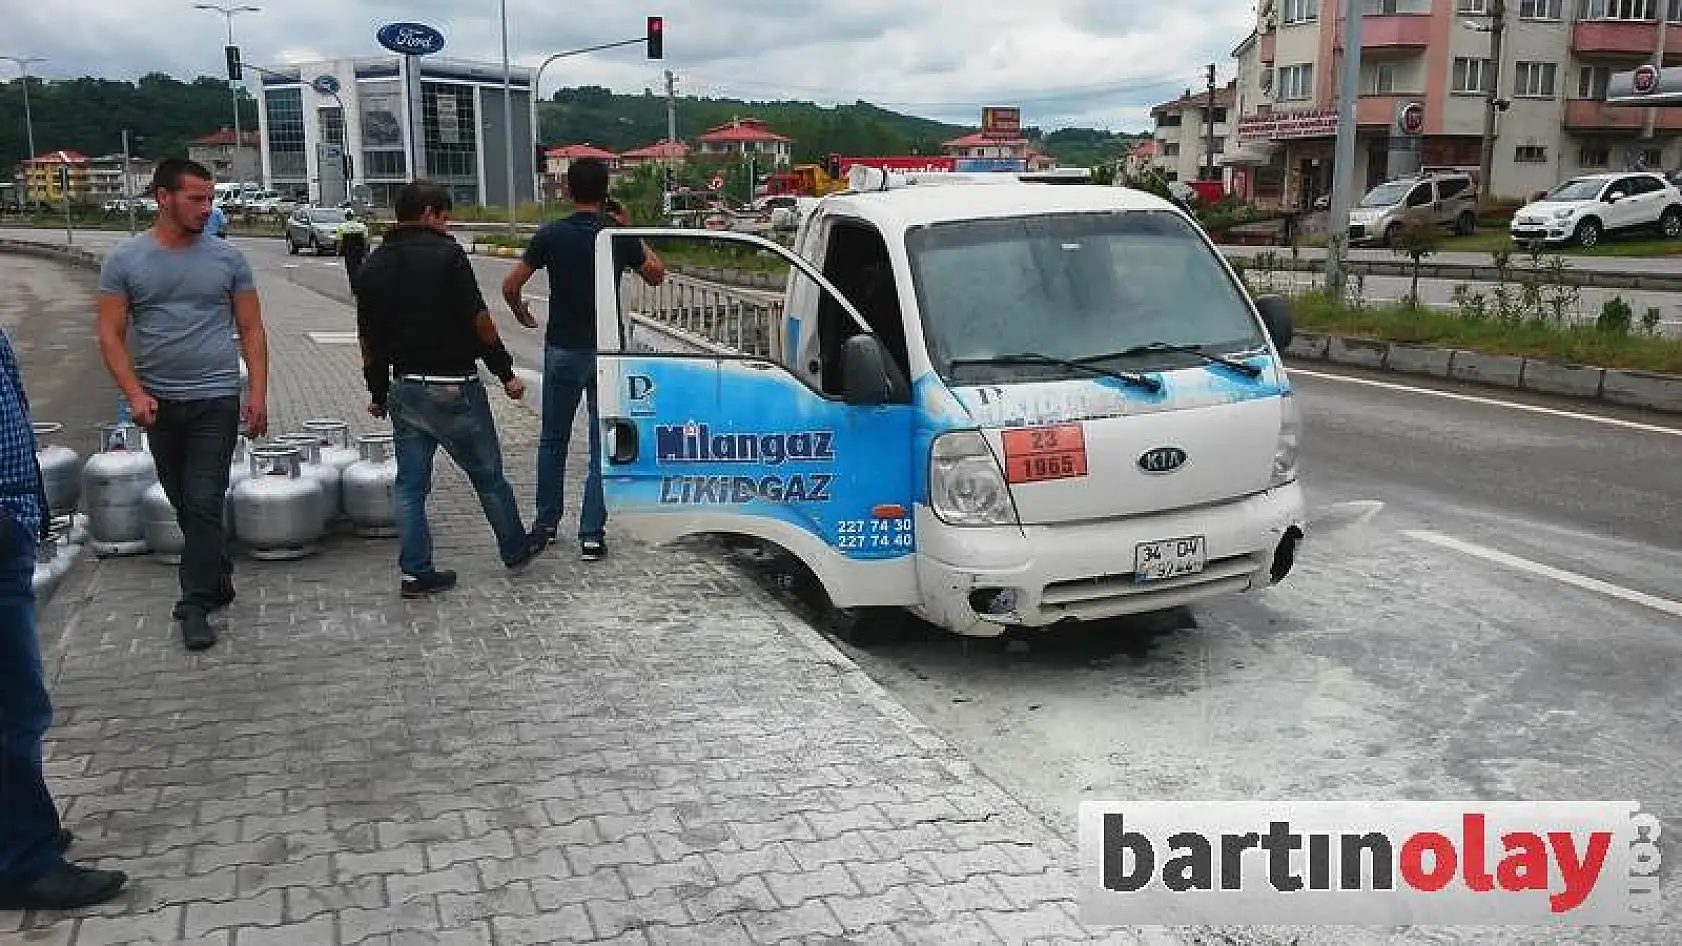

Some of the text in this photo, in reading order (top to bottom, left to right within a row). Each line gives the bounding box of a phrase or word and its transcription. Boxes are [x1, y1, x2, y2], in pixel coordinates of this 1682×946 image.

[394, 28, 433, 48] Ford
[656, 422, 835, 467] Milangaz
[1031, 430, 1059, 449] 23
[1024, 455, 1074, 479] 1965
[1147, 450, 1182, 469] KIA
[838, 518, 911, 533] 227 74 30
[838, 533, 911, 548] 227 74 40
